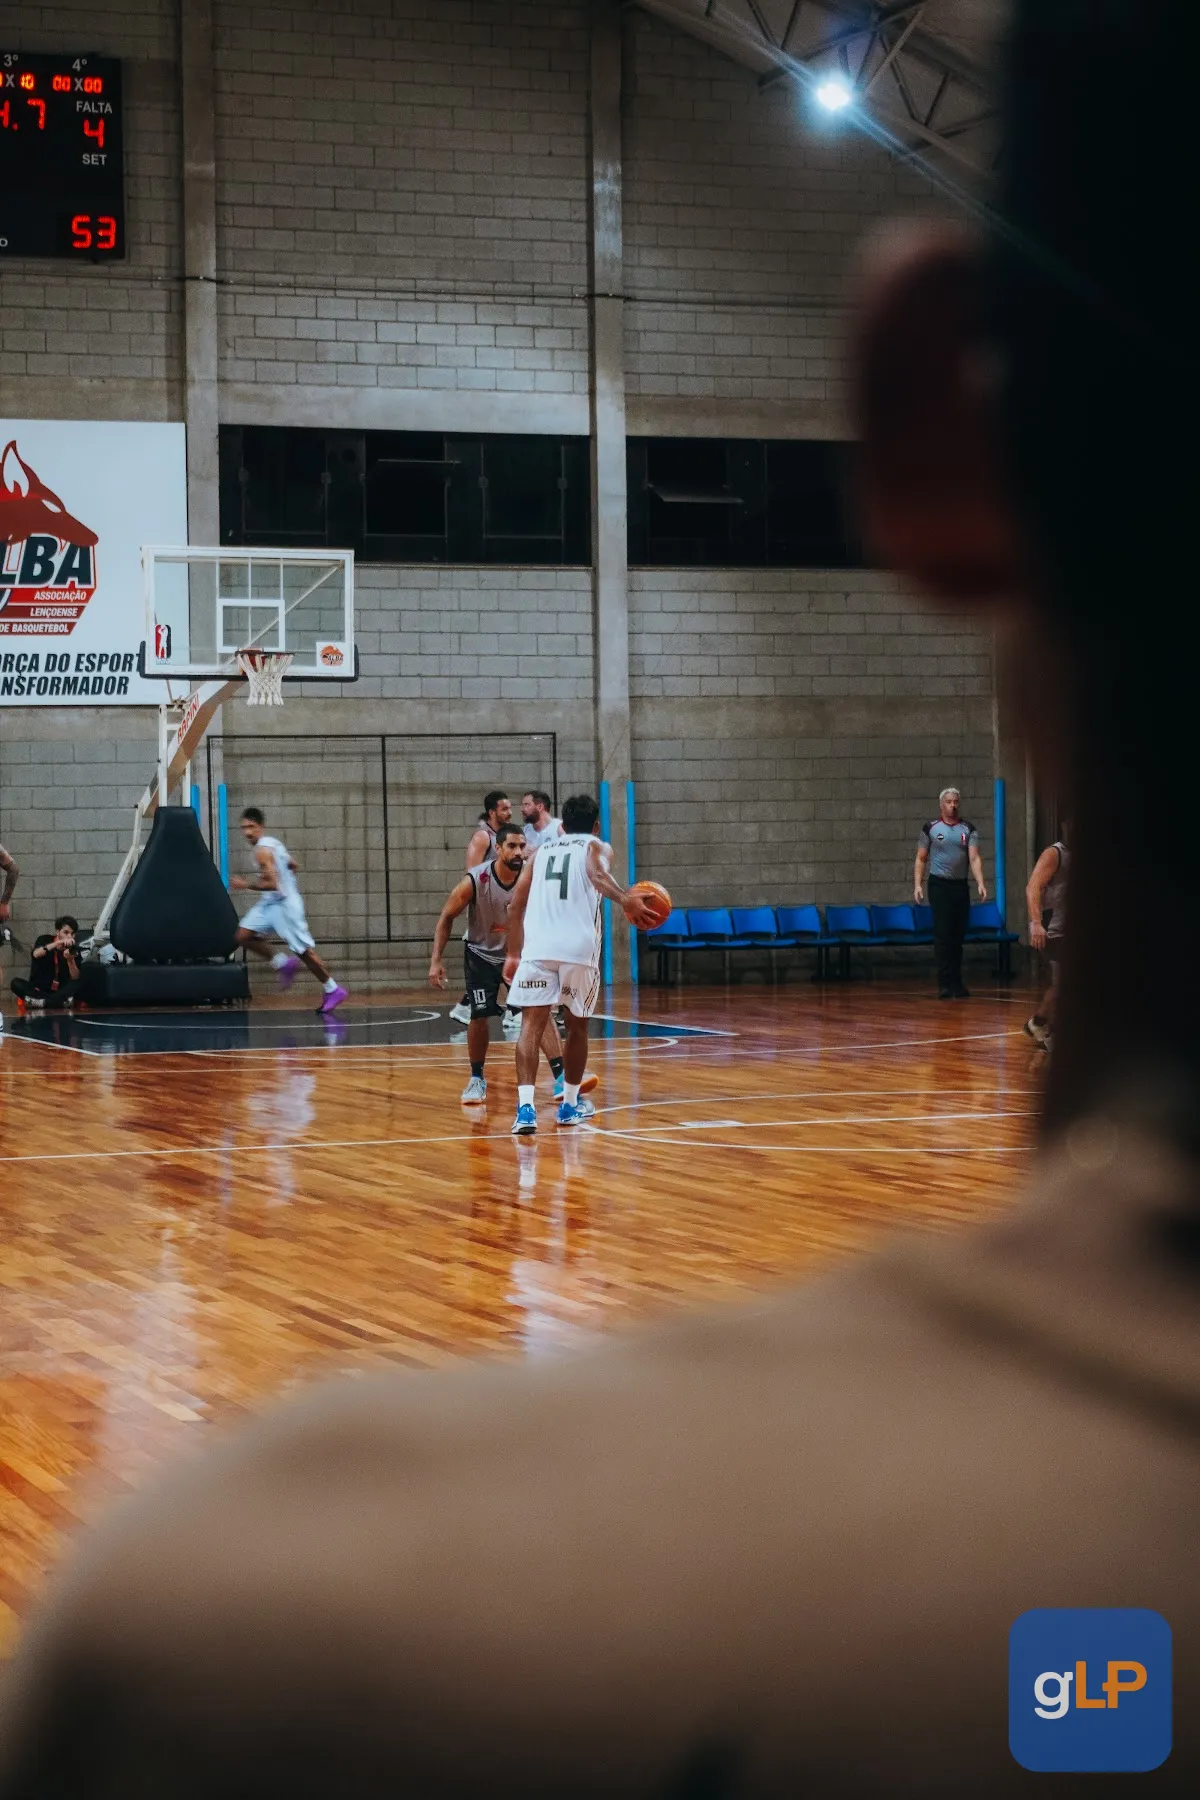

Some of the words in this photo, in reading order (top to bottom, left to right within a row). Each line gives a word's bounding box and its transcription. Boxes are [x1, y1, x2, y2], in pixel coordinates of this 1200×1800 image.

[76, 101, 113, 114] FALTA
[83, 118, 105, 148] 4
[82, 153, 107, 166] SET
[71, 214, 117, 249] 53
[34, 590, 87, 602] ASSOCIAÇÃO
[30, 607, 79, 618] LENÇOENSE
[12, 623, 69, 634] BASQUETEBOL
[0, 653, 40, 677] RÇA
[44, 653, 71, 673] DO
[545, 852, 572, 901] 4
[472, 988, 487, 1004] 10
